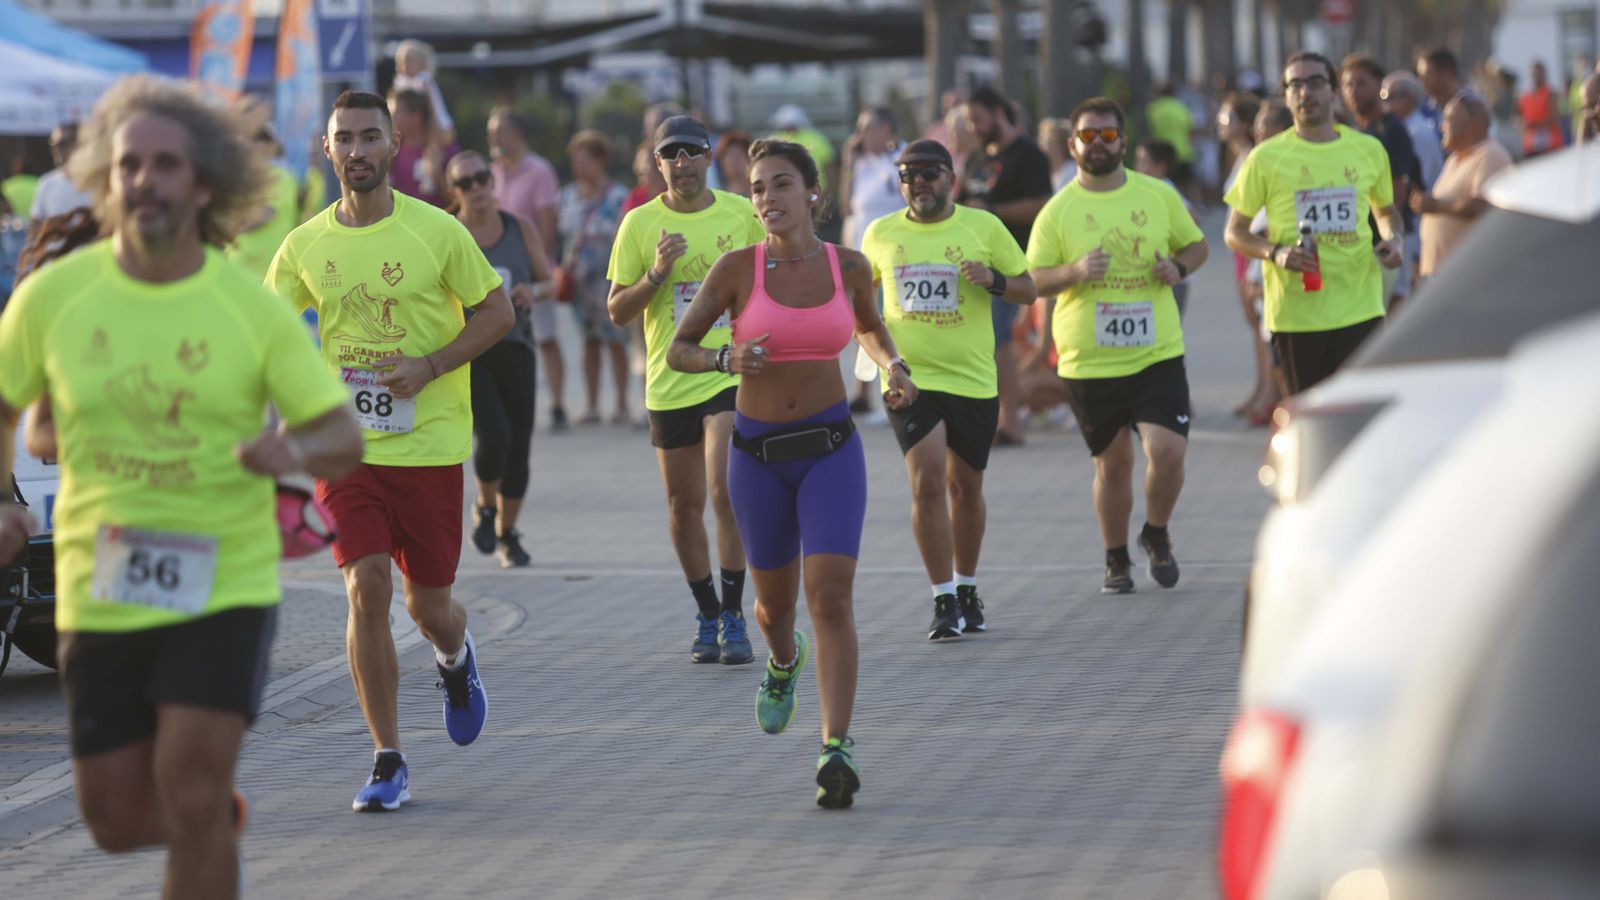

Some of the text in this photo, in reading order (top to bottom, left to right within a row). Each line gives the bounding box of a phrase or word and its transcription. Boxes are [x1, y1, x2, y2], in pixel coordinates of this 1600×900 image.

[1305, 202, 1350, 222] 415
[903, 280, 949, 300] 204
[1105, 316, 1147, 336] 401
[338, 354, 371, 365] POR LA
[355, 390, 393, 417] 68
[126, 550, 180, 593] 56
